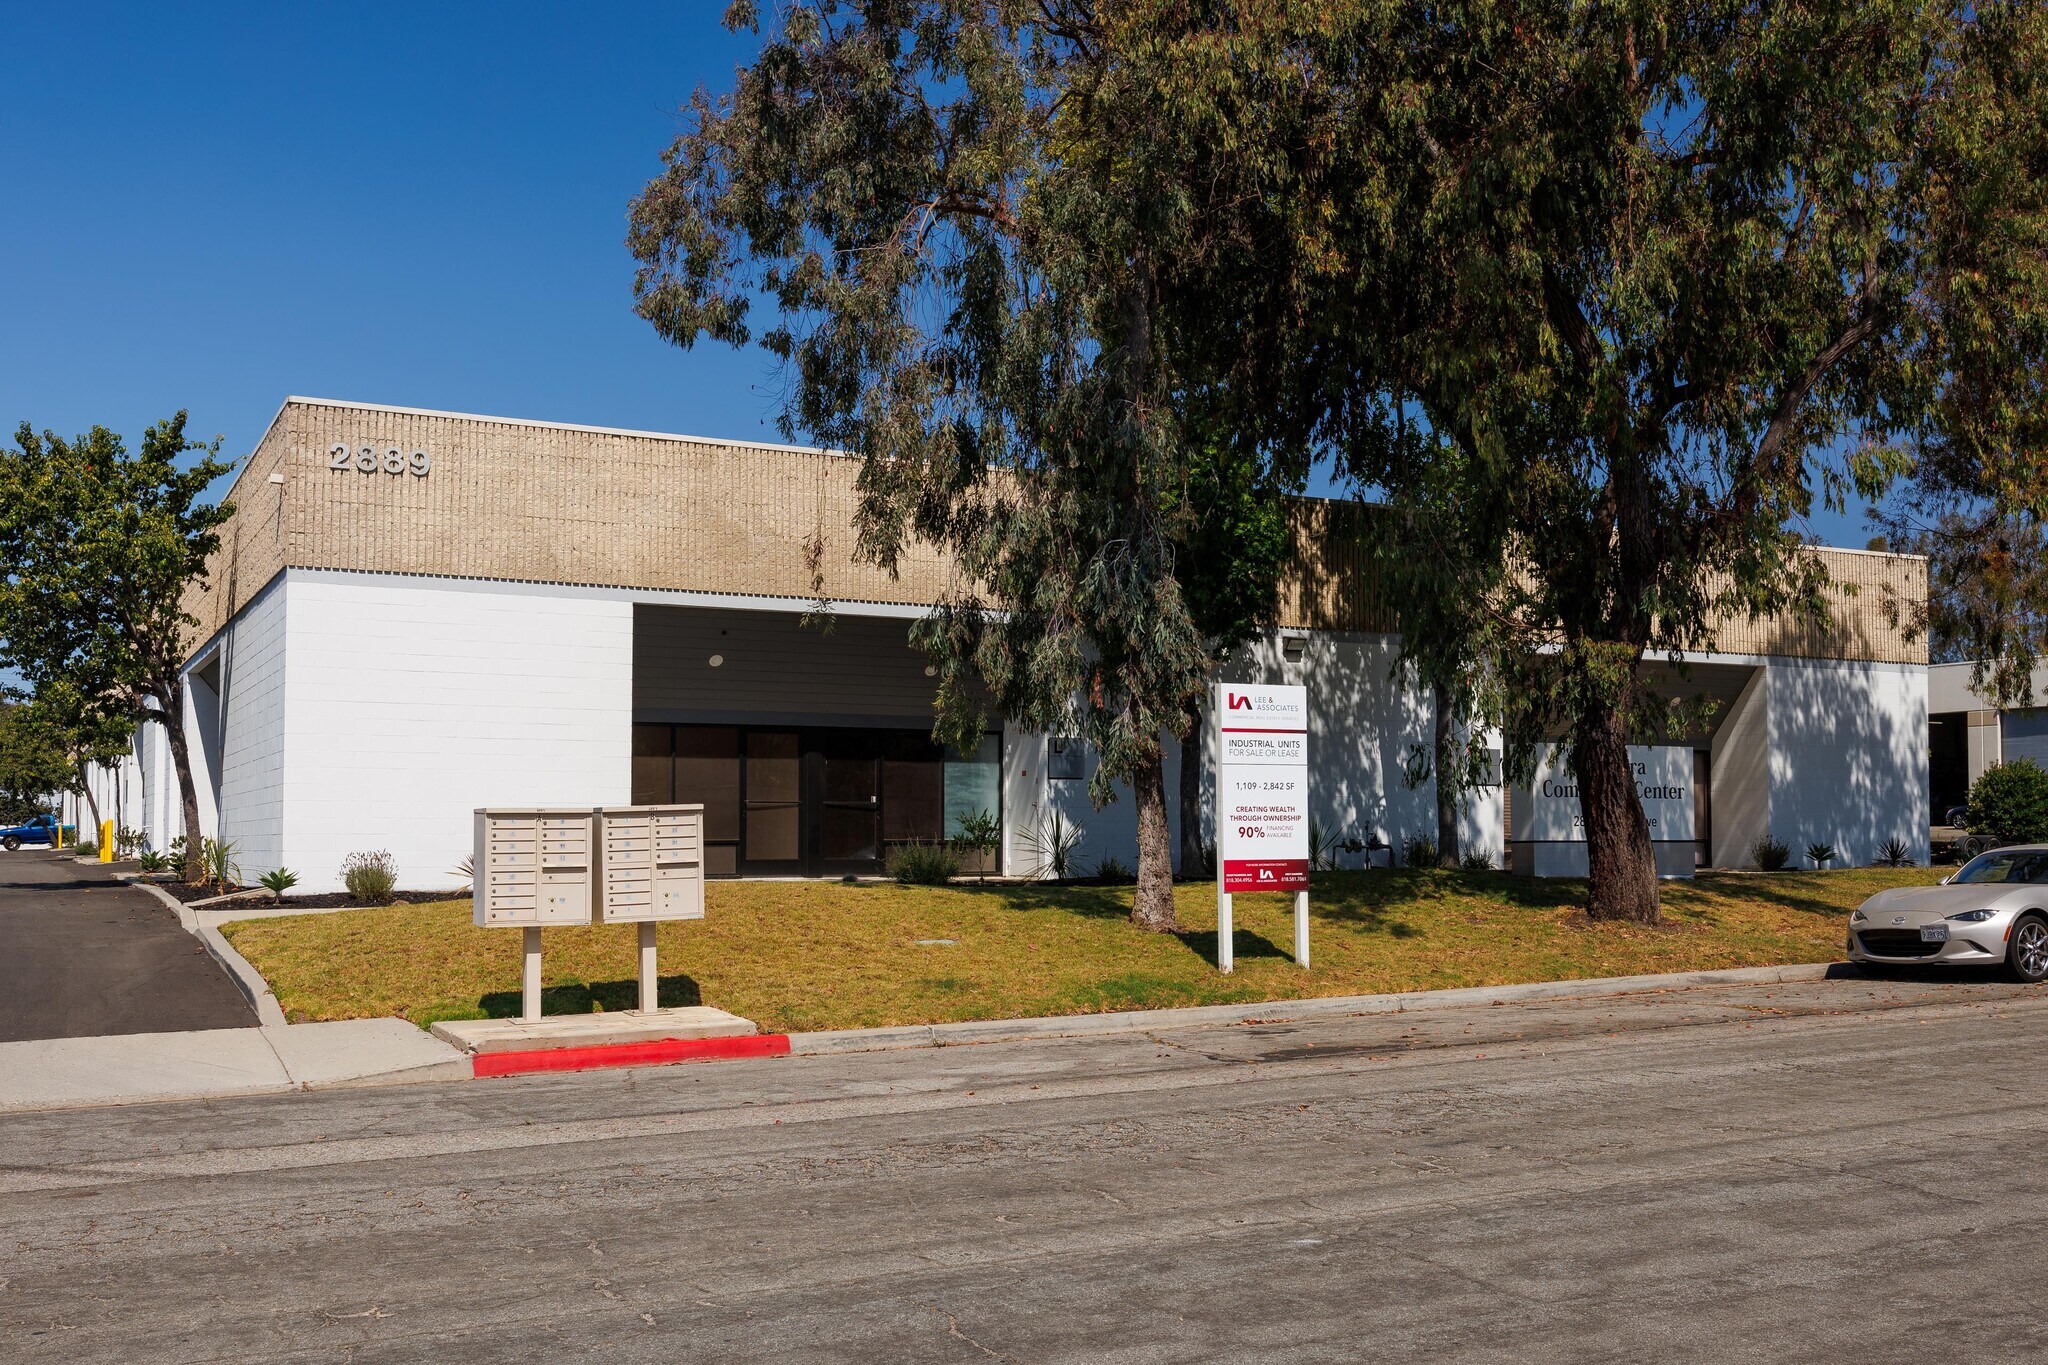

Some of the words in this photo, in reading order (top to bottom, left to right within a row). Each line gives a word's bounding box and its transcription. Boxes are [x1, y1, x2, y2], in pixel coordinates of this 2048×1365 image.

[330, 441, 431, 476] 2889
[1257, 704, 1299, 712] ASSOCIATES
[1228, 739, 1274, 748] INDUSTRIAL
[1278, 740, 1301, 749] UNITS
[1229, 748, 1244, 756] FOR
[1246, 749, 1263, 757] SALE
[1265, 749, 1276, 757] OR
[1278, 749, 1299, 757] LEASE
[1236, 782, 1257, 790] 1,109
[1263, 782, 1284, 791] 2,842
[1286, 782, 1295, 790] SF
[1635, 781, 1684, 799] Center
[536, 814, 542, 822] A
[1238, 826, 1265, 838] 90%
